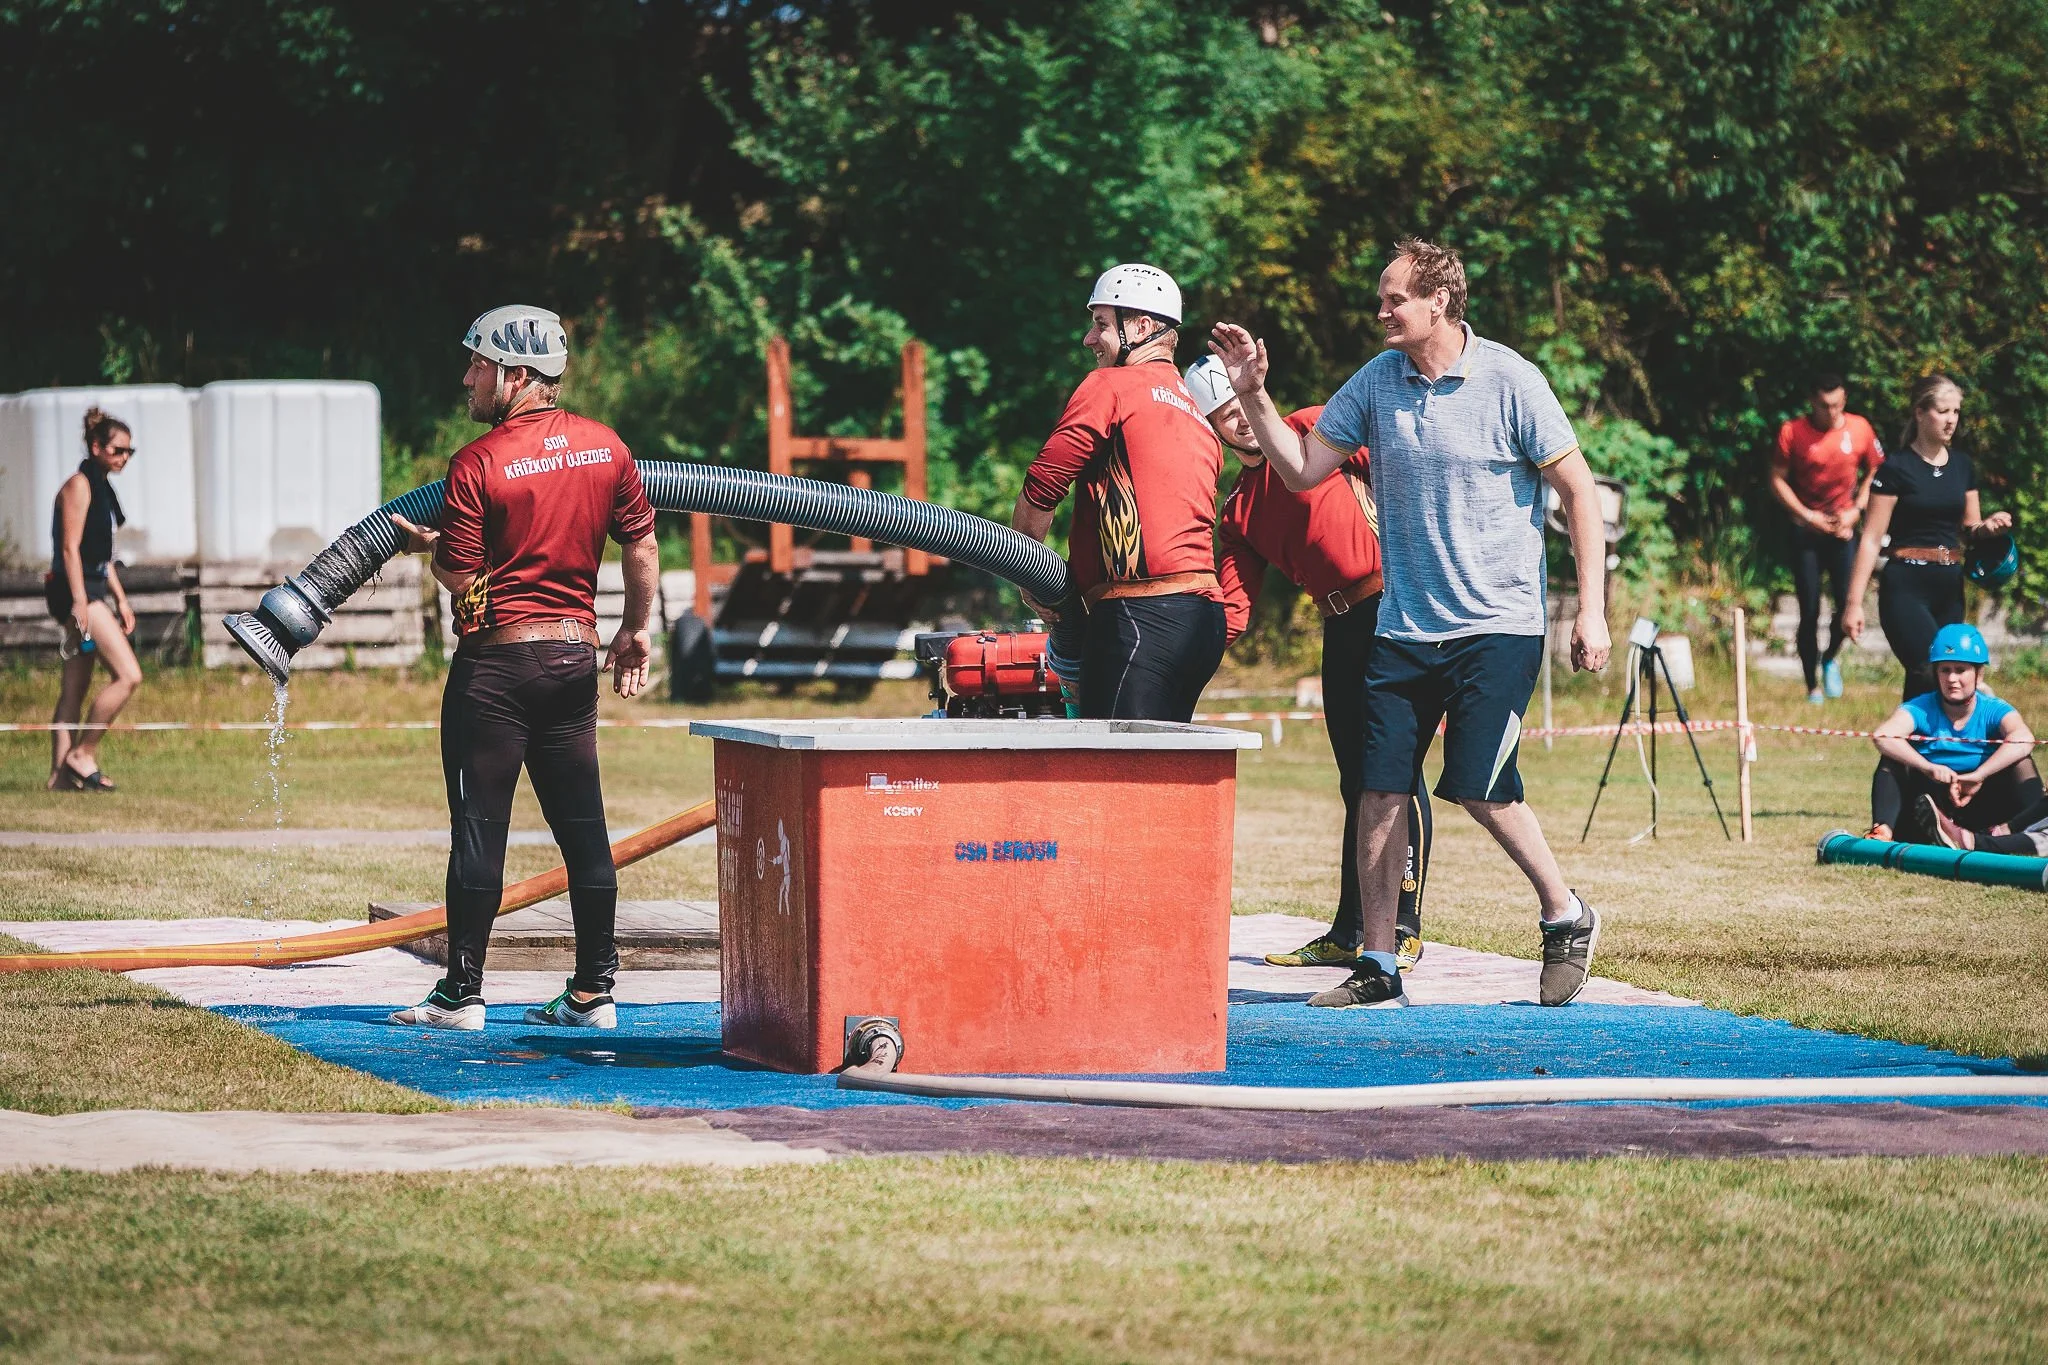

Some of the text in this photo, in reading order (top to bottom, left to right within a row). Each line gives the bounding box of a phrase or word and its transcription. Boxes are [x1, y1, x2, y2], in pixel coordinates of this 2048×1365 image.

[543, 434, 569, 451] SDH
[503, 447, 613, 480] KŘÍŽKOVÝ ÚJEZDEC
[883, 805, 923, 817] KOSKY
